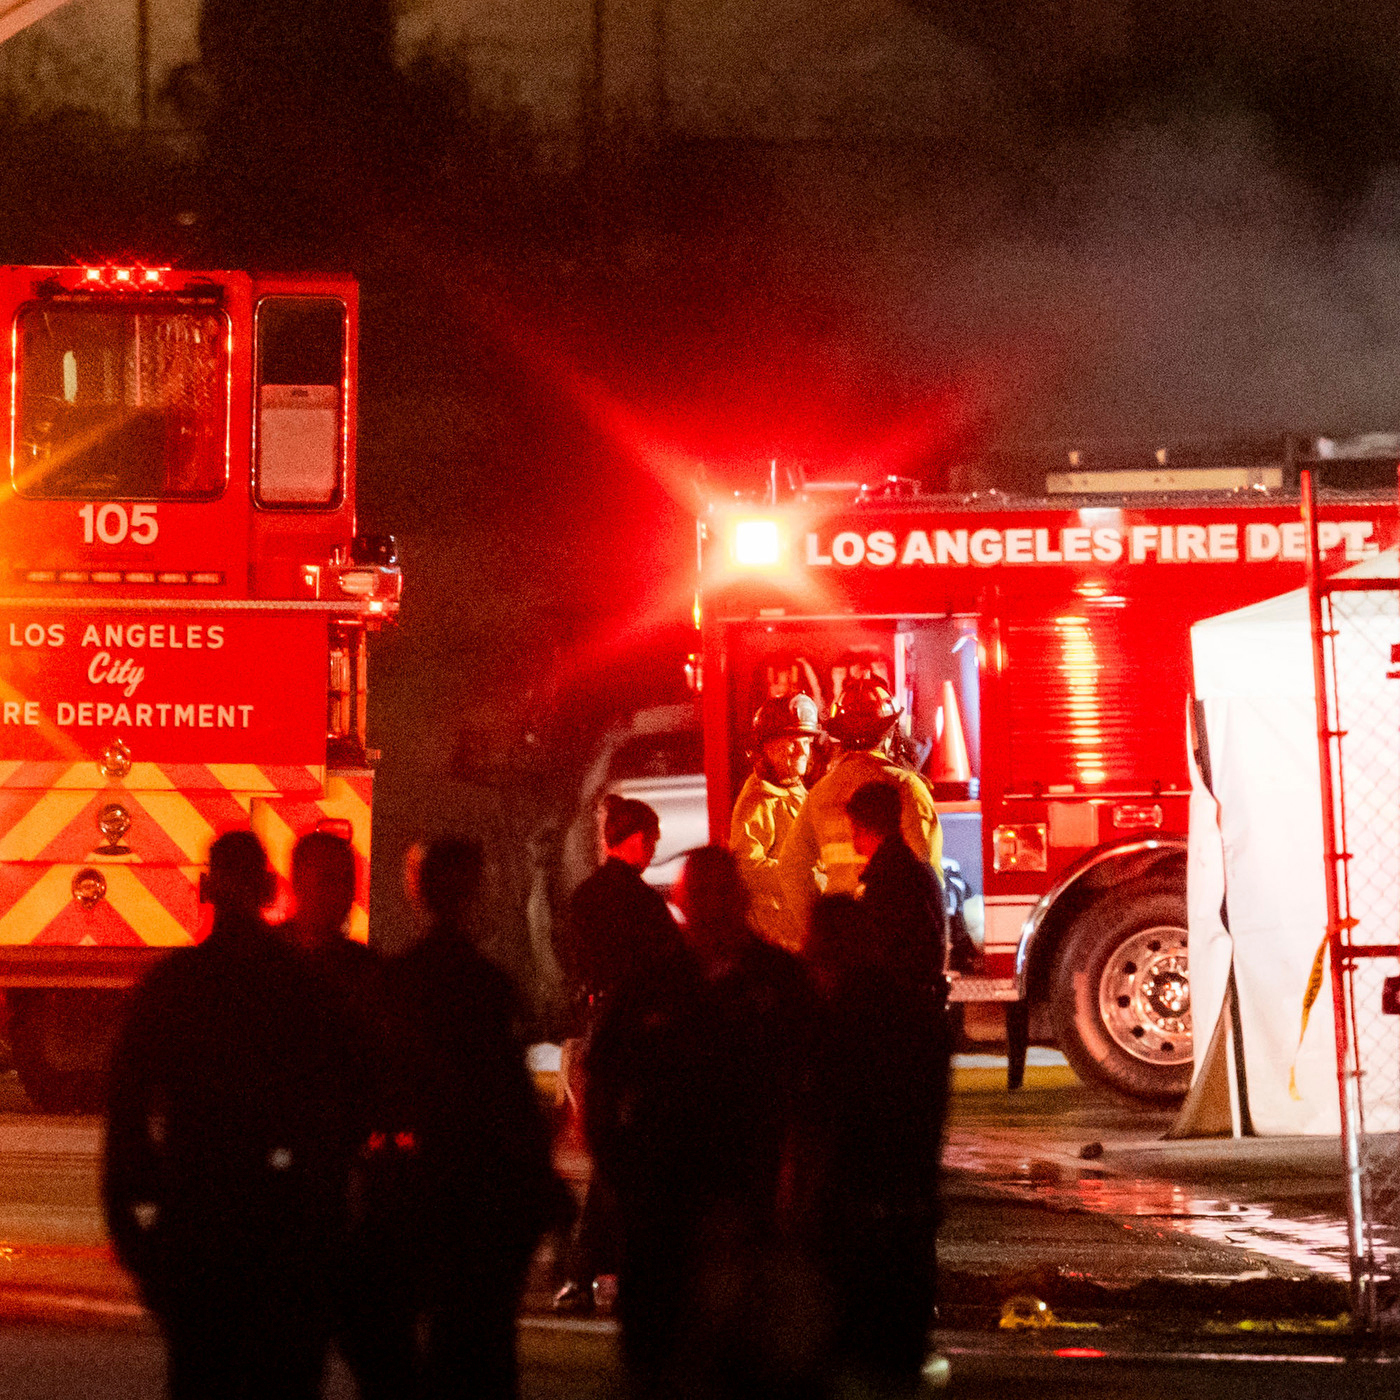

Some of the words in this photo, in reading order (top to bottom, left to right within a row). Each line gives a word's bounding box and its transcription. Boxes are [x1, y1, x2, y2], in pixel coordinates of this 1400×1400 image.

[78, 502, 159, 545] 105
[805, 531, 897, 567] LOS
[900, 527, 1124, 565] ANGELES
[1128, 524, 1239, 563] FIRE
[1243, 521, 1381, 561] DEPT.
[9, 622, 66, 647] LOS
[81, 624, 225, 649] ANGELES
[87, 651, 145, 698] City
[56, 703, 255, 728] DEPARTMENT
